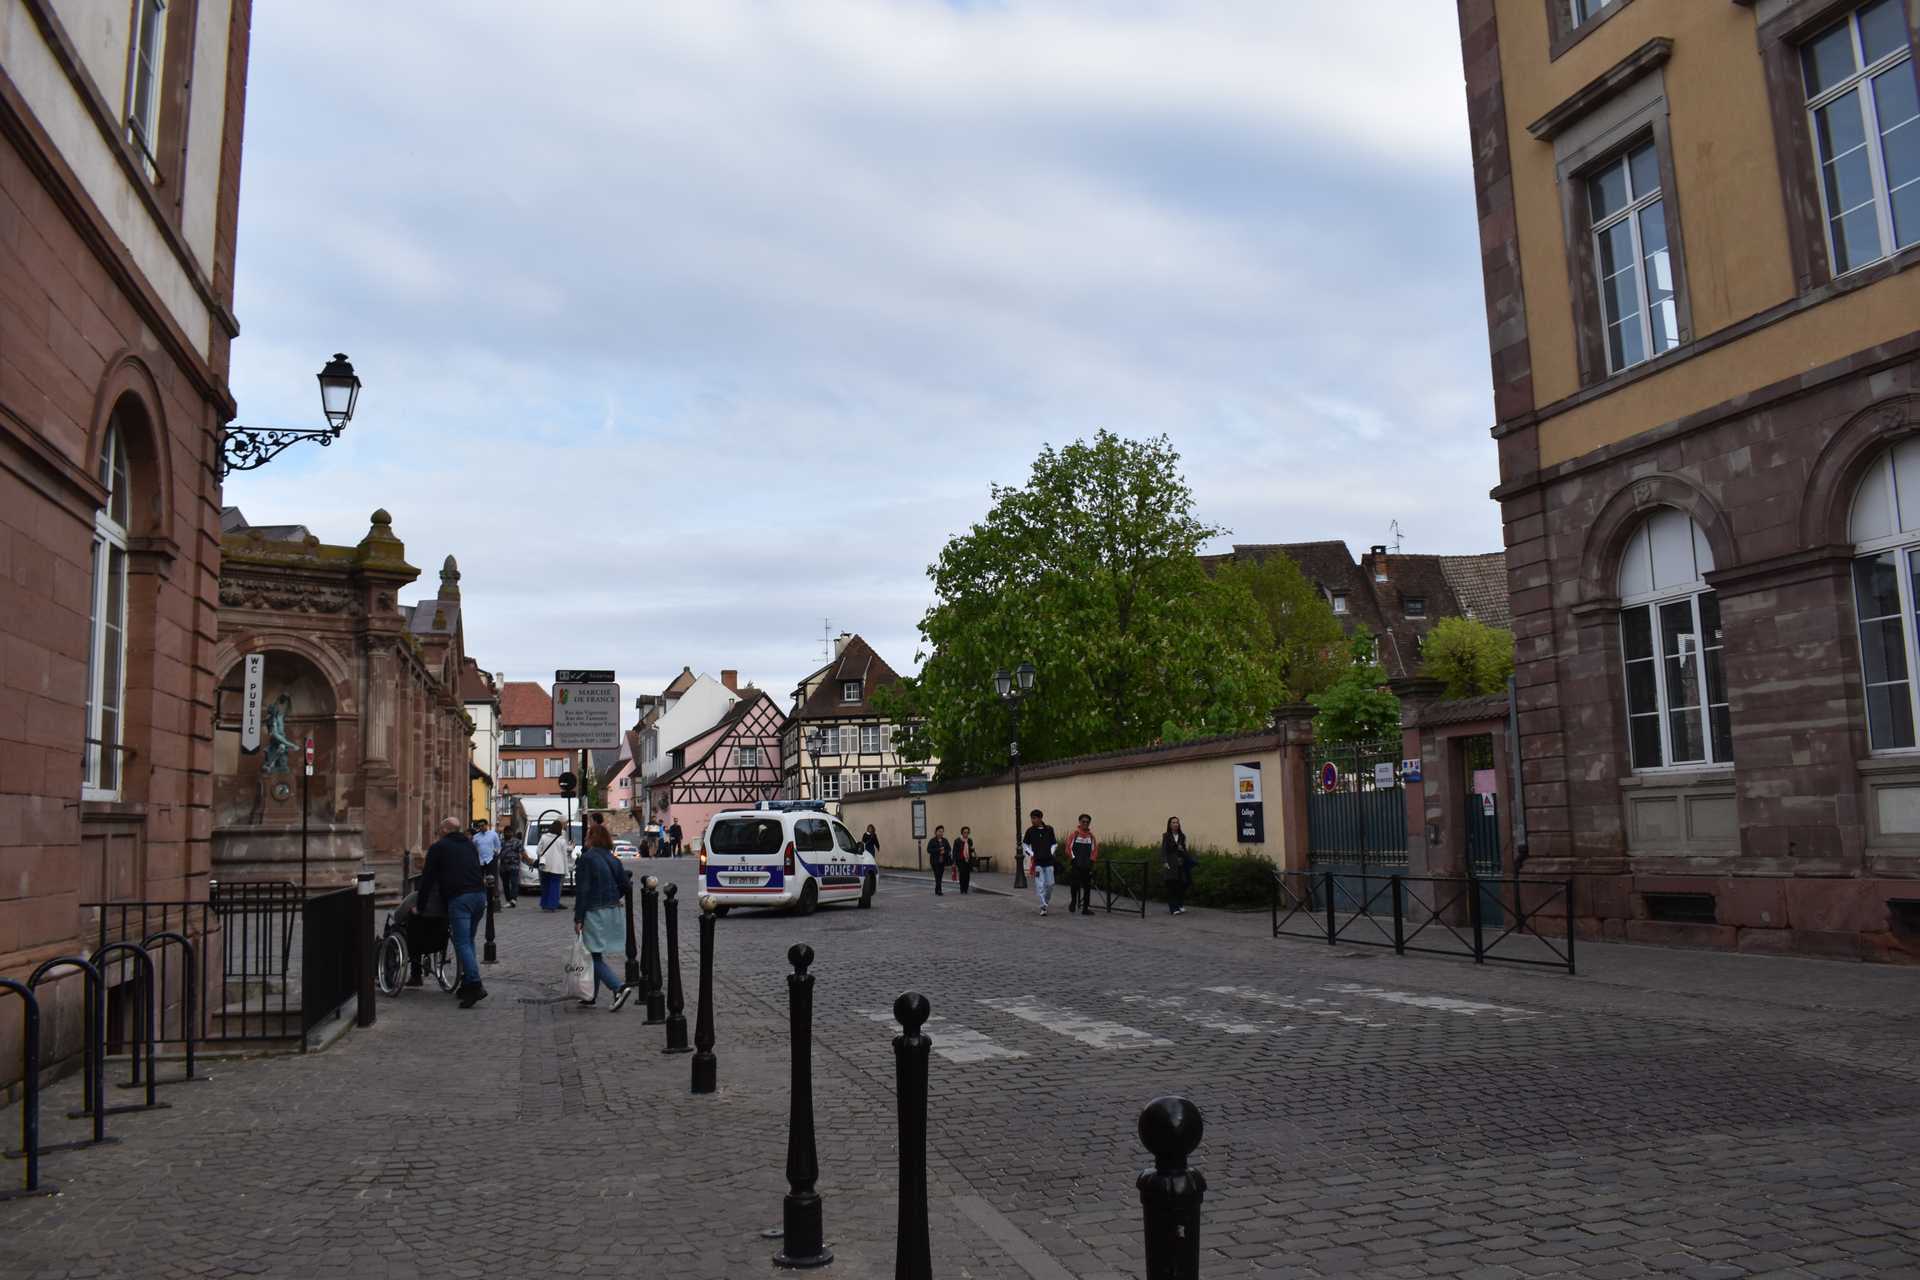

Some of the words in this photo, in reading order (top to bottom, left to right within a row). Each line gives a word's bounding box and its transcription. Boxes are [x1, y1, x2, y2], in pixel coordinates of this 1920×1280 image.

[250, 657, 260, 673] WC
[248, 683, 257, 734] PUBLIC
[824, 864, 851, 876] POLICE
